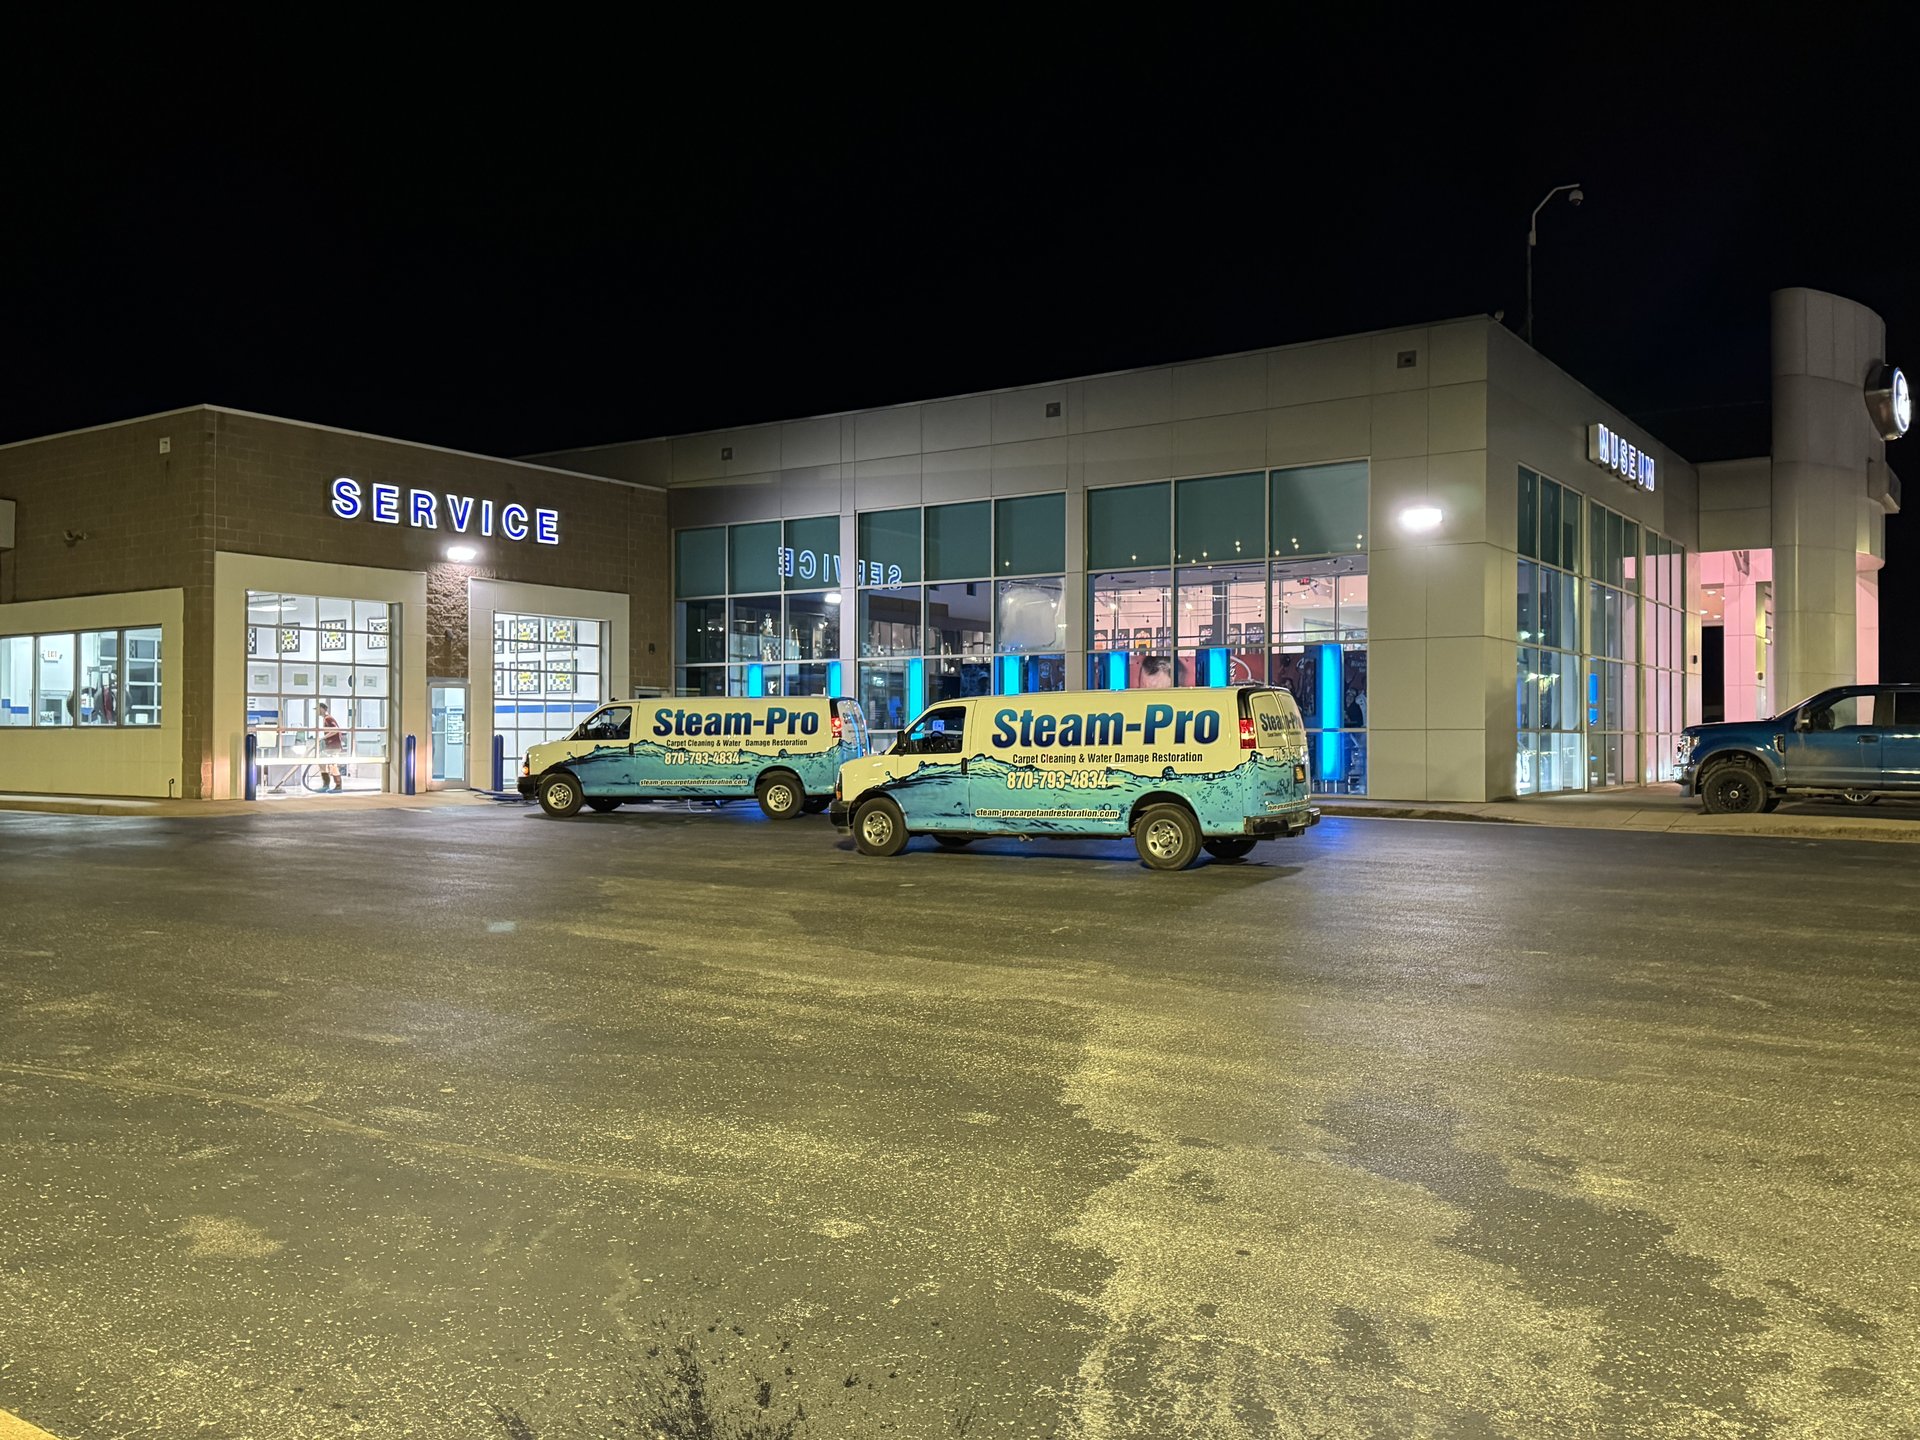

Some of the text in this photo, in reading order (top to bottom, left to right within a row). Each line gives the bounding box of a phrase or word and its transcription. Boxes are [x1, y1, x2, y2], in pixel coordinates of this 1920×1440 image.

[1598, 422, 1656, 492] MUSEUM
[330, 476, 561, 546] SERVICE
[652, 707, 819, 737] Steam-Pro
[991, 703, 1220, 748] Steam-Pro
[666, 738, 808, 749] Carpet Cleaning & Water Damage Restoration
[664, 751, 740, 765] 870-793-4834
[1012, 752, 1203, 765] Carpet Cleaning & Water Damage Restoration
[1006, 769, 1108, 789] 870-793-4834
[975, 808, 1119, 819] steam-procarpetandrestoration.com
